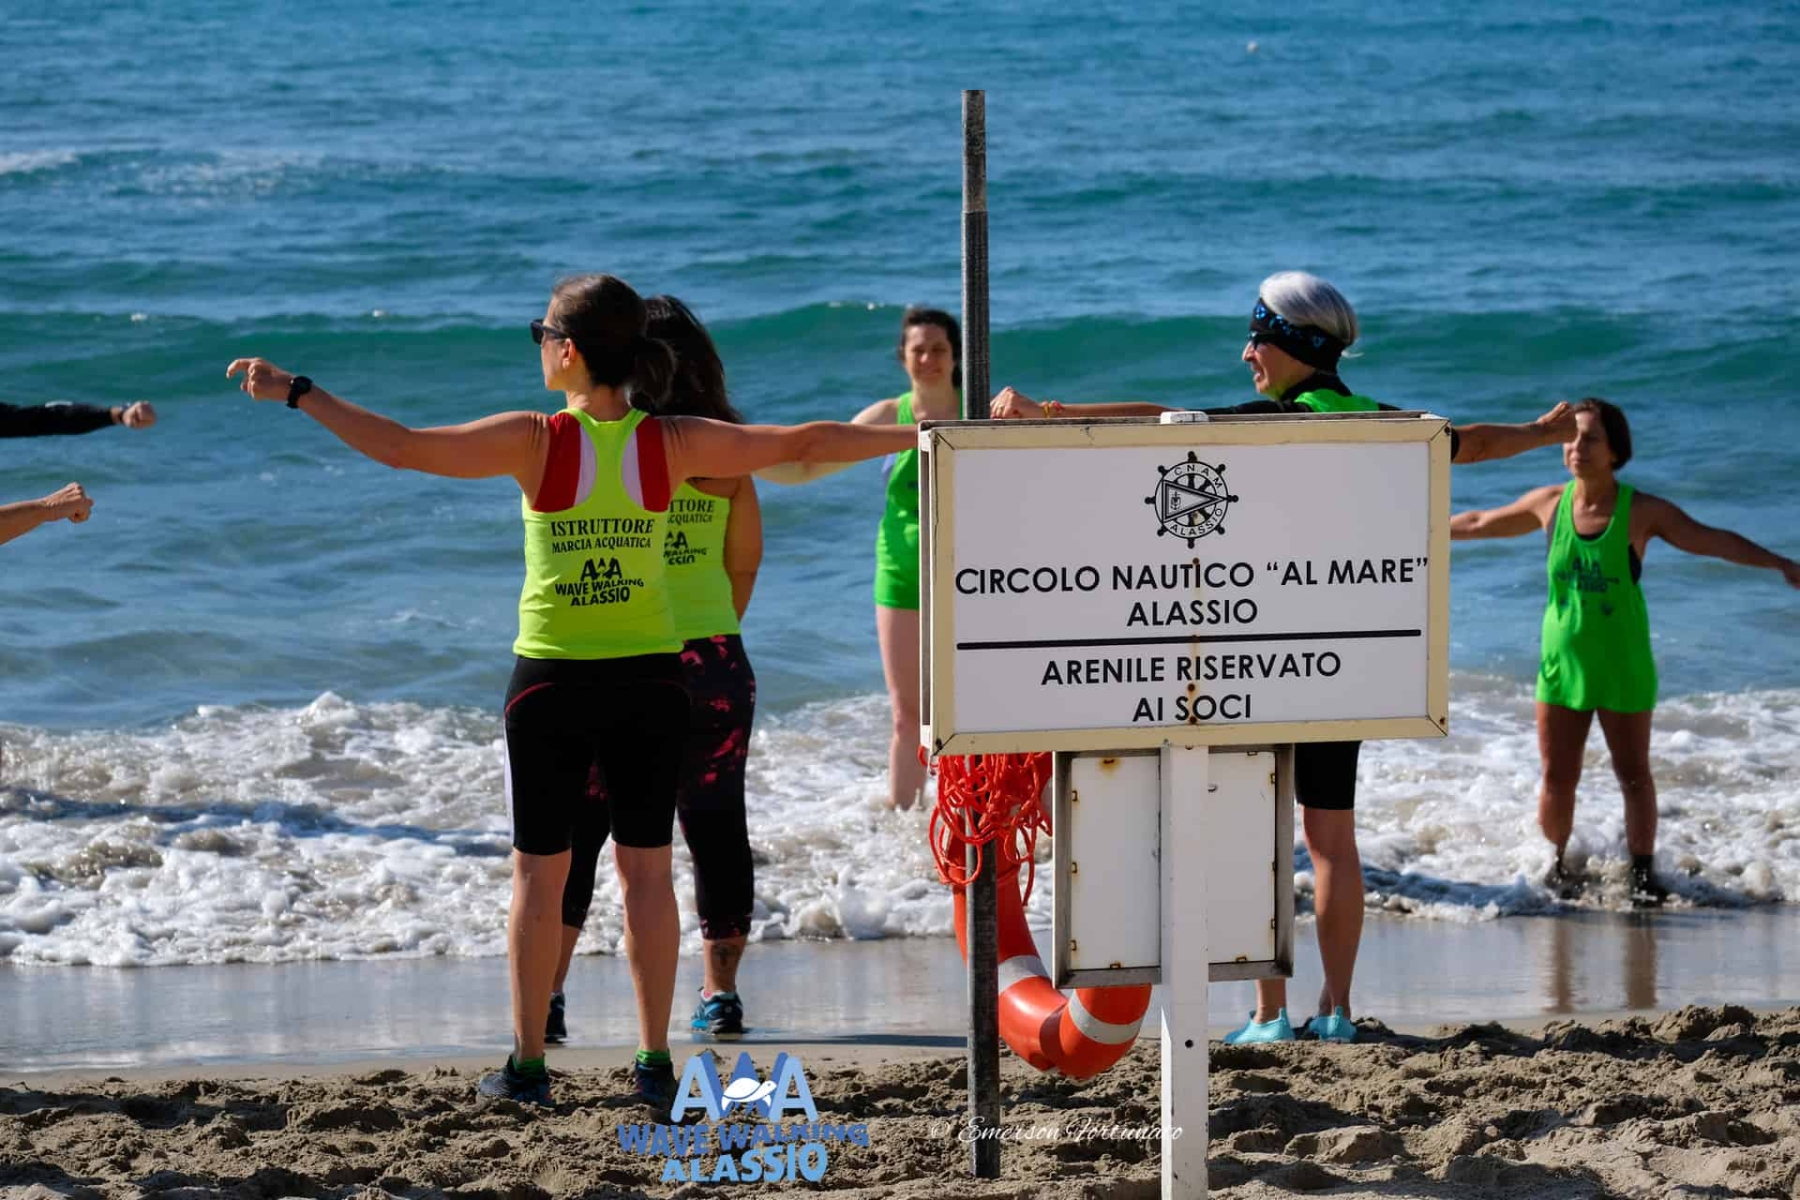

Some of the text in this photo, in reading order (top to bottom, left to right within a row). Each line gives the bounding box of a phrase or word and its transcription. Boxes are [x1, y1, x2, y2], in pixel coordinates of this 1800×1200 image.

[551, 518, 655, 537] ISTRUTTORE
[1170, 508, 1223, 536] ALASSIO
[552, 538, 592, 554] MARCIA
[595, 536, 651, 550] ACQUATICA
[555, 578, 645, 596] WAVE WALKING
[955, 566, 1100, 594] CIRCOLO
[1112, 562, 1255, 590] NAUTICO
[570, 586, 631, 607] ALASSIO
[1126, 598, 1258, 627] ALASSIO
[1041, 651, 1341, 685] ARENILE RISERVATO
[1133, 694, 1251, 722] AI SOCI
